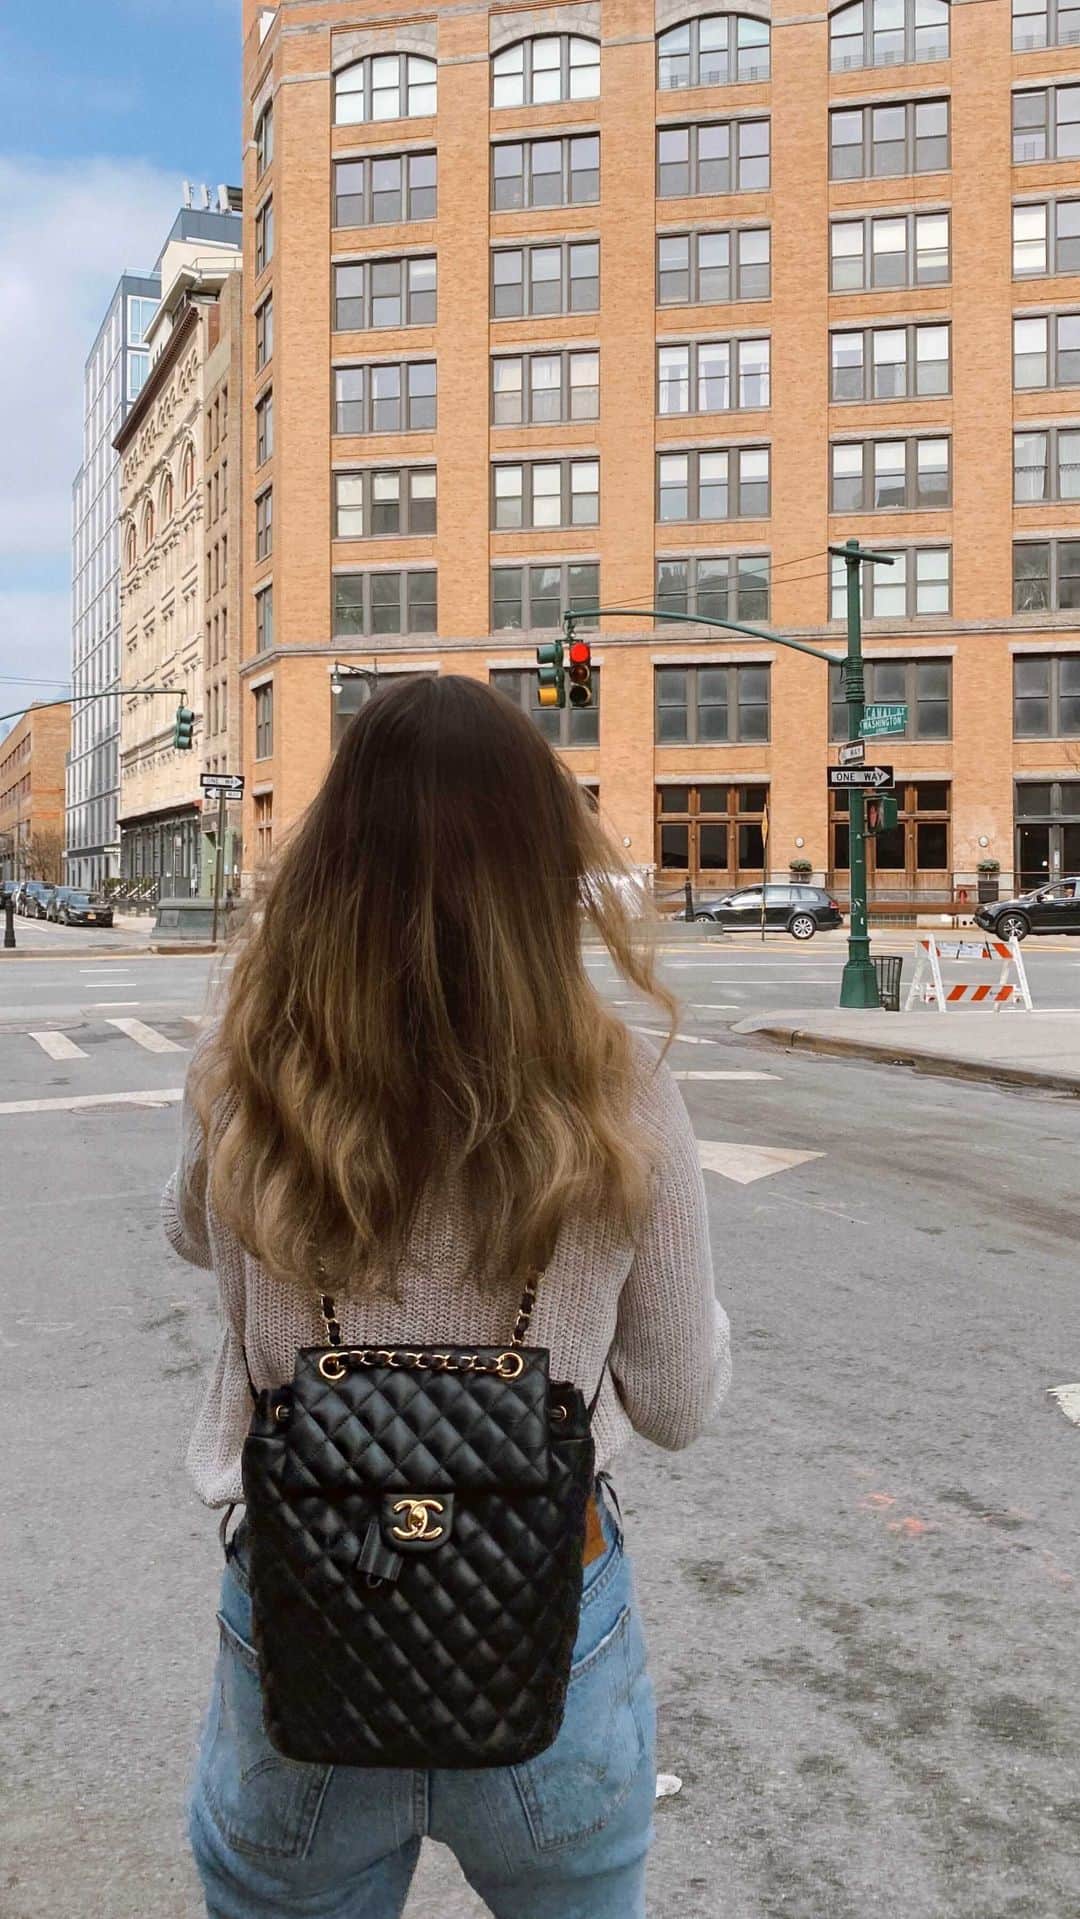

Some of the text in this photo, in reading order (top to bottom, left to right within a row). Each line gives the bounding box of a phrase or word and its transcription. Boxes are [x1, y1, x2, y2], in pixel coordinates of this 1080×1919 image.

[863, 716, 901, 730] WASHINGTON
[836, 772, 884, 781] ONE WAY
